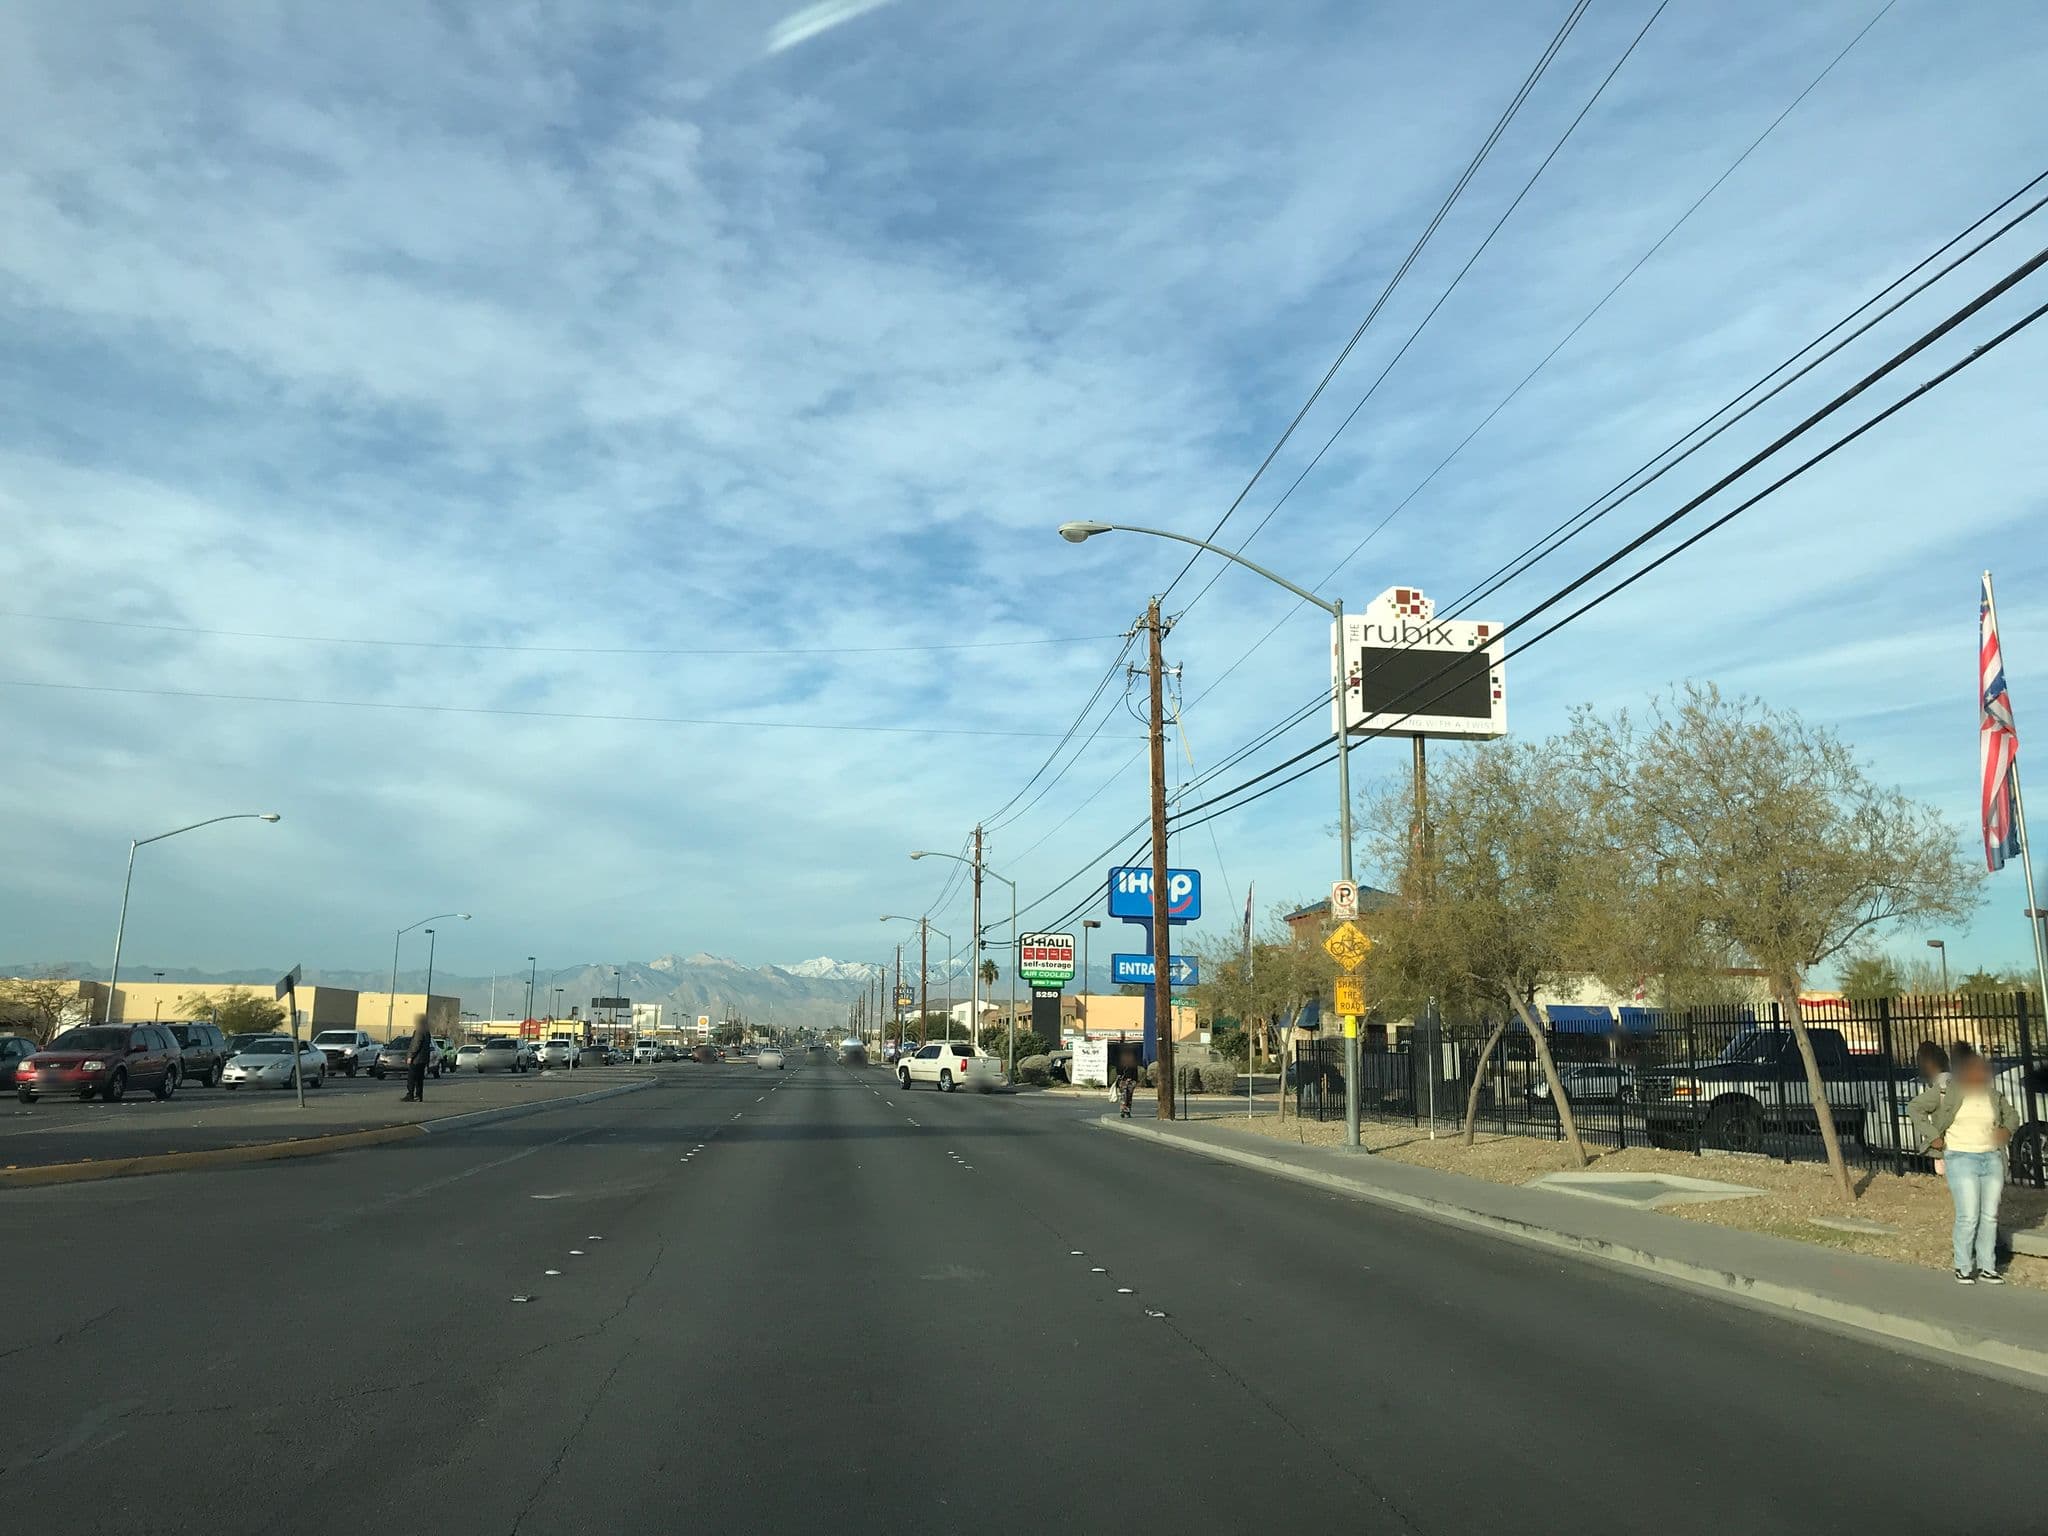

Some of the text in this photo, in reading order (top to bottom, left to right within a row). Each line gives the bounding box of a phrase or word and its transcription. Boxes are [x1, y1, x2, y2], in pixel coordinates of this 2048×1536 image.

[1350, 624, 1359, 642] THE
[1363, 620, 1453, 645] rubix
[1024, 937, 1072, 947] U-HAUL
[1024, 961, 1071, 969] self-storage
[1343, 991, 1359, 999] THE
[1340, 1002, 1361, 1011] ROAD
